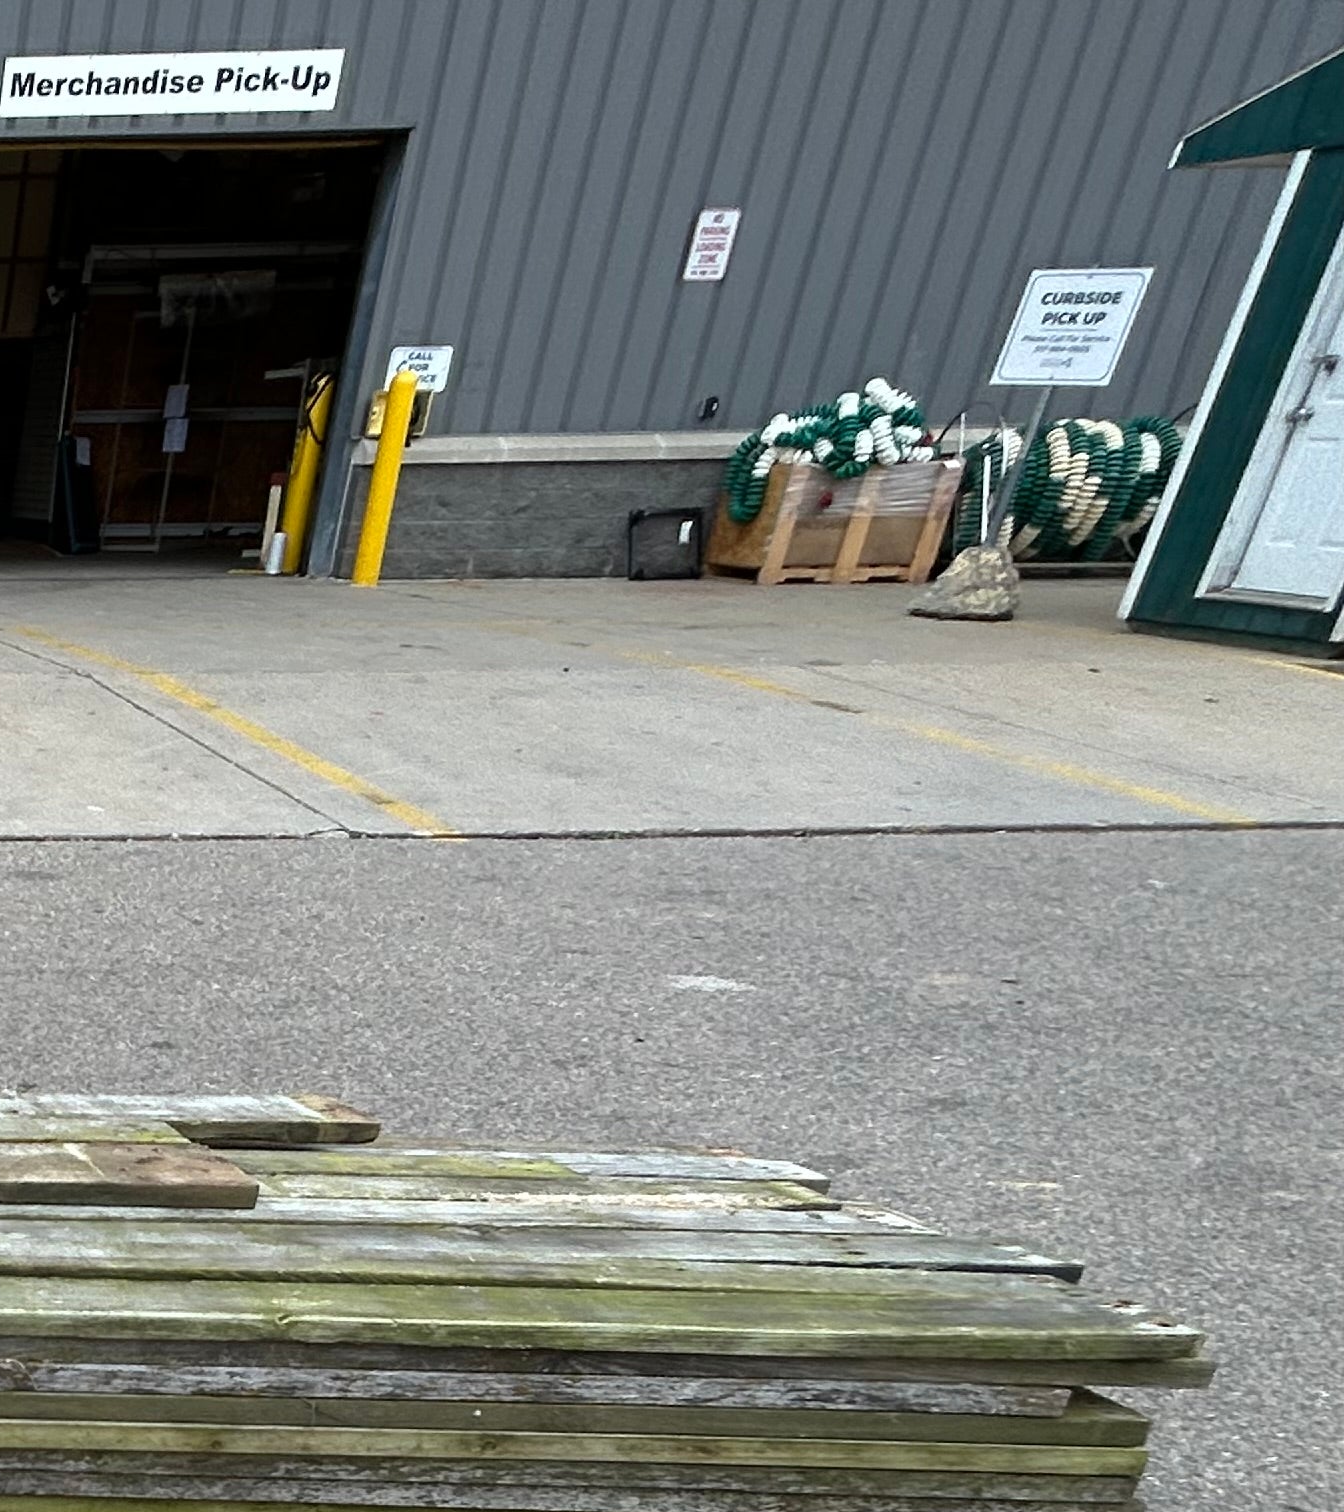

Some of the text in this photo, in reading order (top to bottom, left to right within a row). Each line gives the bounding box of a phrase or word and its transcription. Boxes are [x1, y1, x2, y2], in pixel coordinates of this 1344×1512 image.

[9, 65, 332, 98] Merchandise Pick-Up
[1040, 291, 1123, 305] CURBSIDE
[1041, 312, 1108, 325] PICK UP
[408, 352, 433, 360] CALL
[408, 363, 429, 371] FOR
